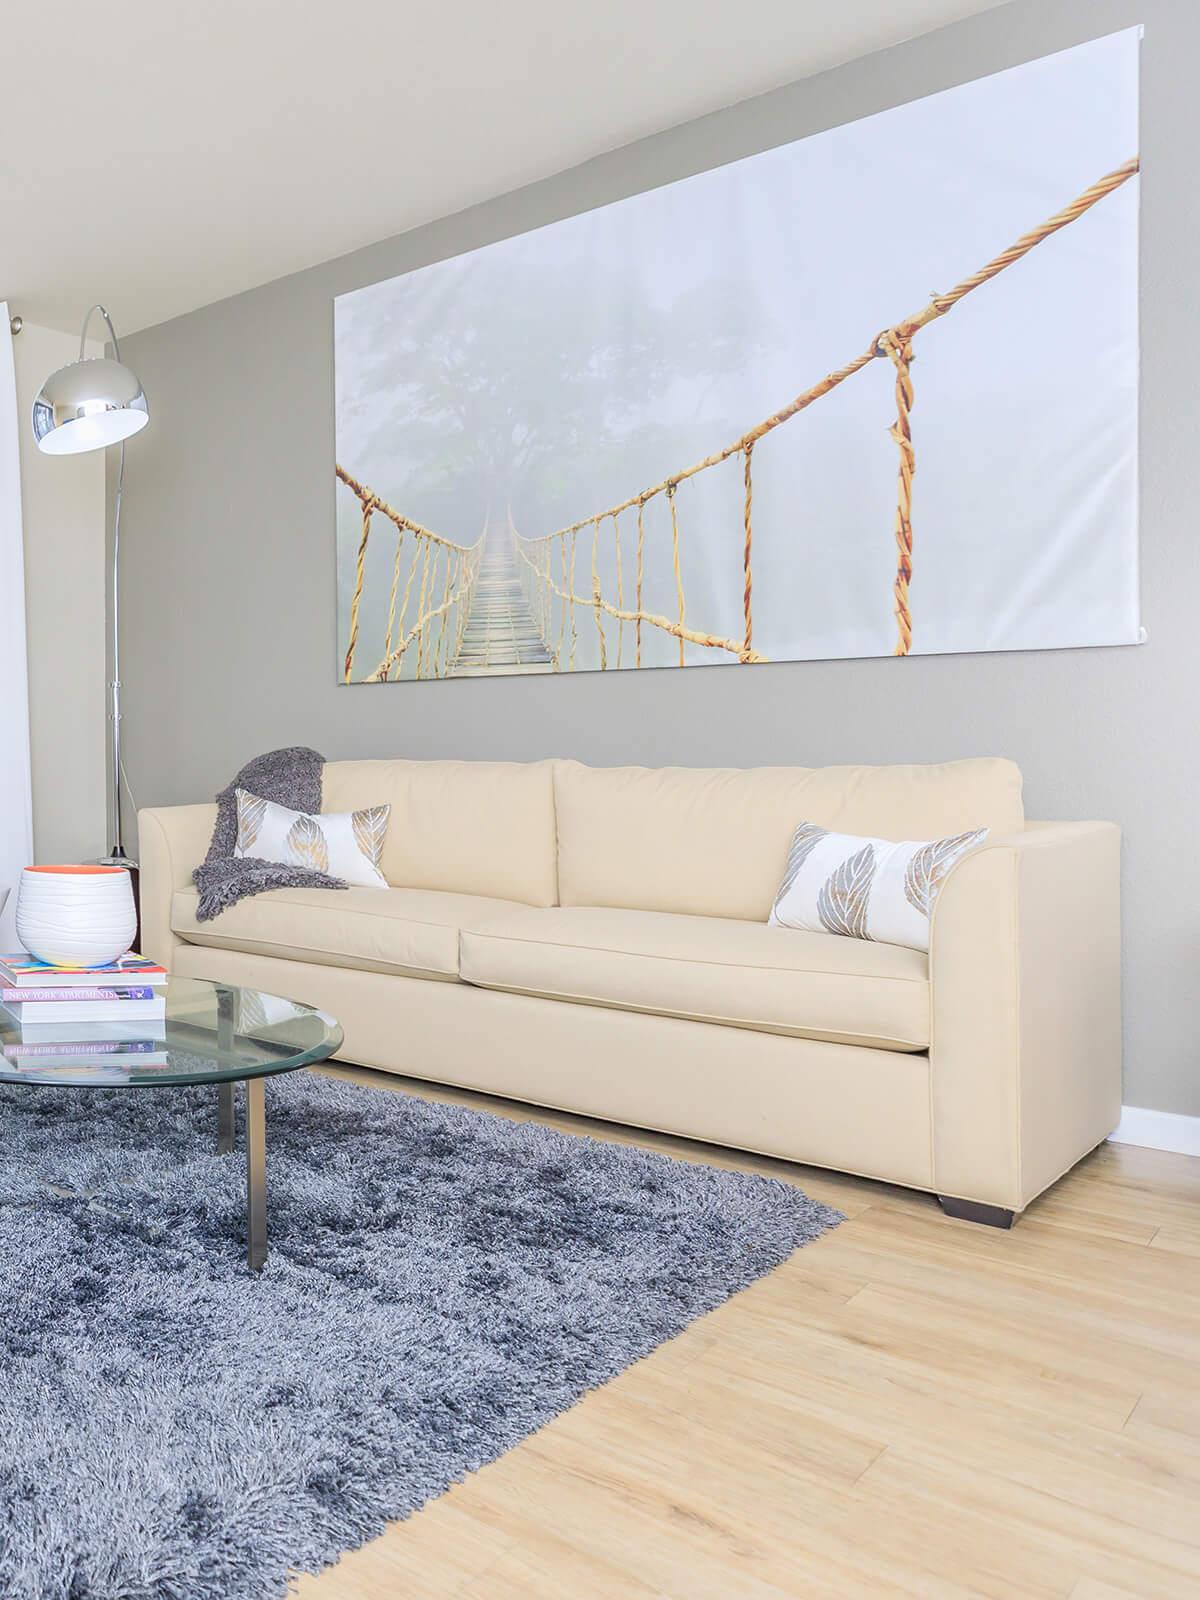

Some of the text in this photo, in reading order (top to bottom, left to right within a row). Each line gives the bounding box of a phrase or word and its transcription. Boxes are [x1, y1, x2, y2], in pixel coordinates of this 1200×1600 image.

[9, 990, 114, 1000] NEW YORK APARTMENTS
